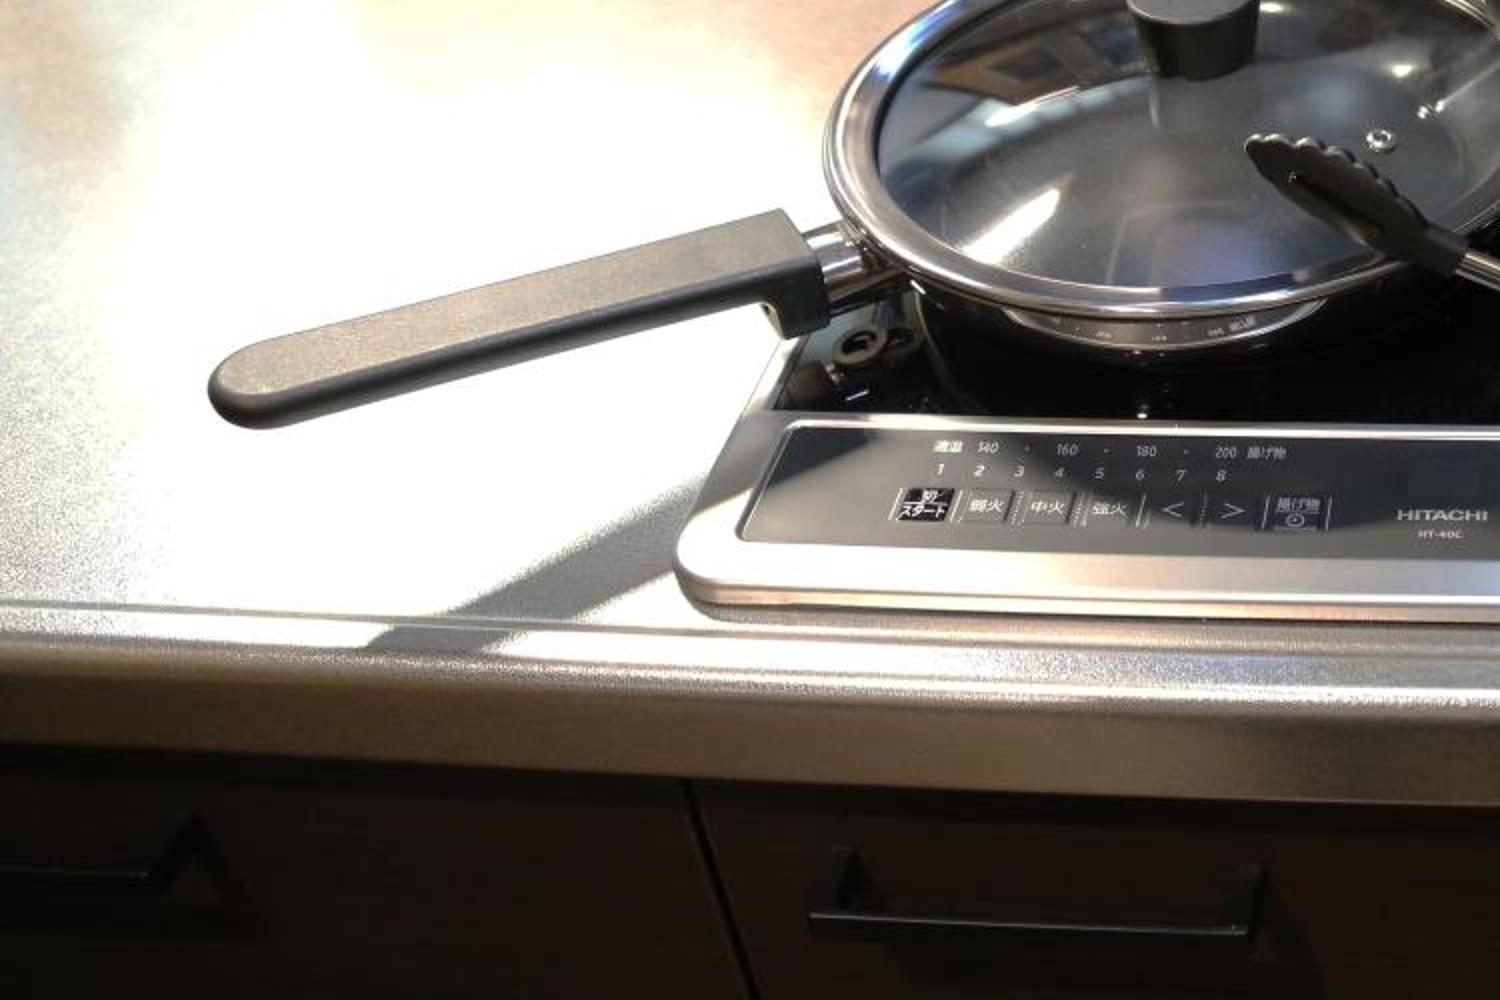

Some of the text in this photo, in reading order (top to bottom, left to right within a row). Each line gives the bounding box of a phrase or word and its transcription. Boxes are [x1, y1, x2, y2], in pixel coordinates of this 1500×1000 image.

[1057, 443, 1079, 455] 160
[1137, 445, 1157, 456] 180
[1216, 446, 1237, 459] 200
[936, 463, 1227, 482] 1 2 3 4 5 6 7 8
[901, 504, 946, 519] スタート
[1031, 500, 1065, 514] 中火
[1092, 502, 1128, 516] 強火
[1397, 509, 1489, 521] HITACHI
